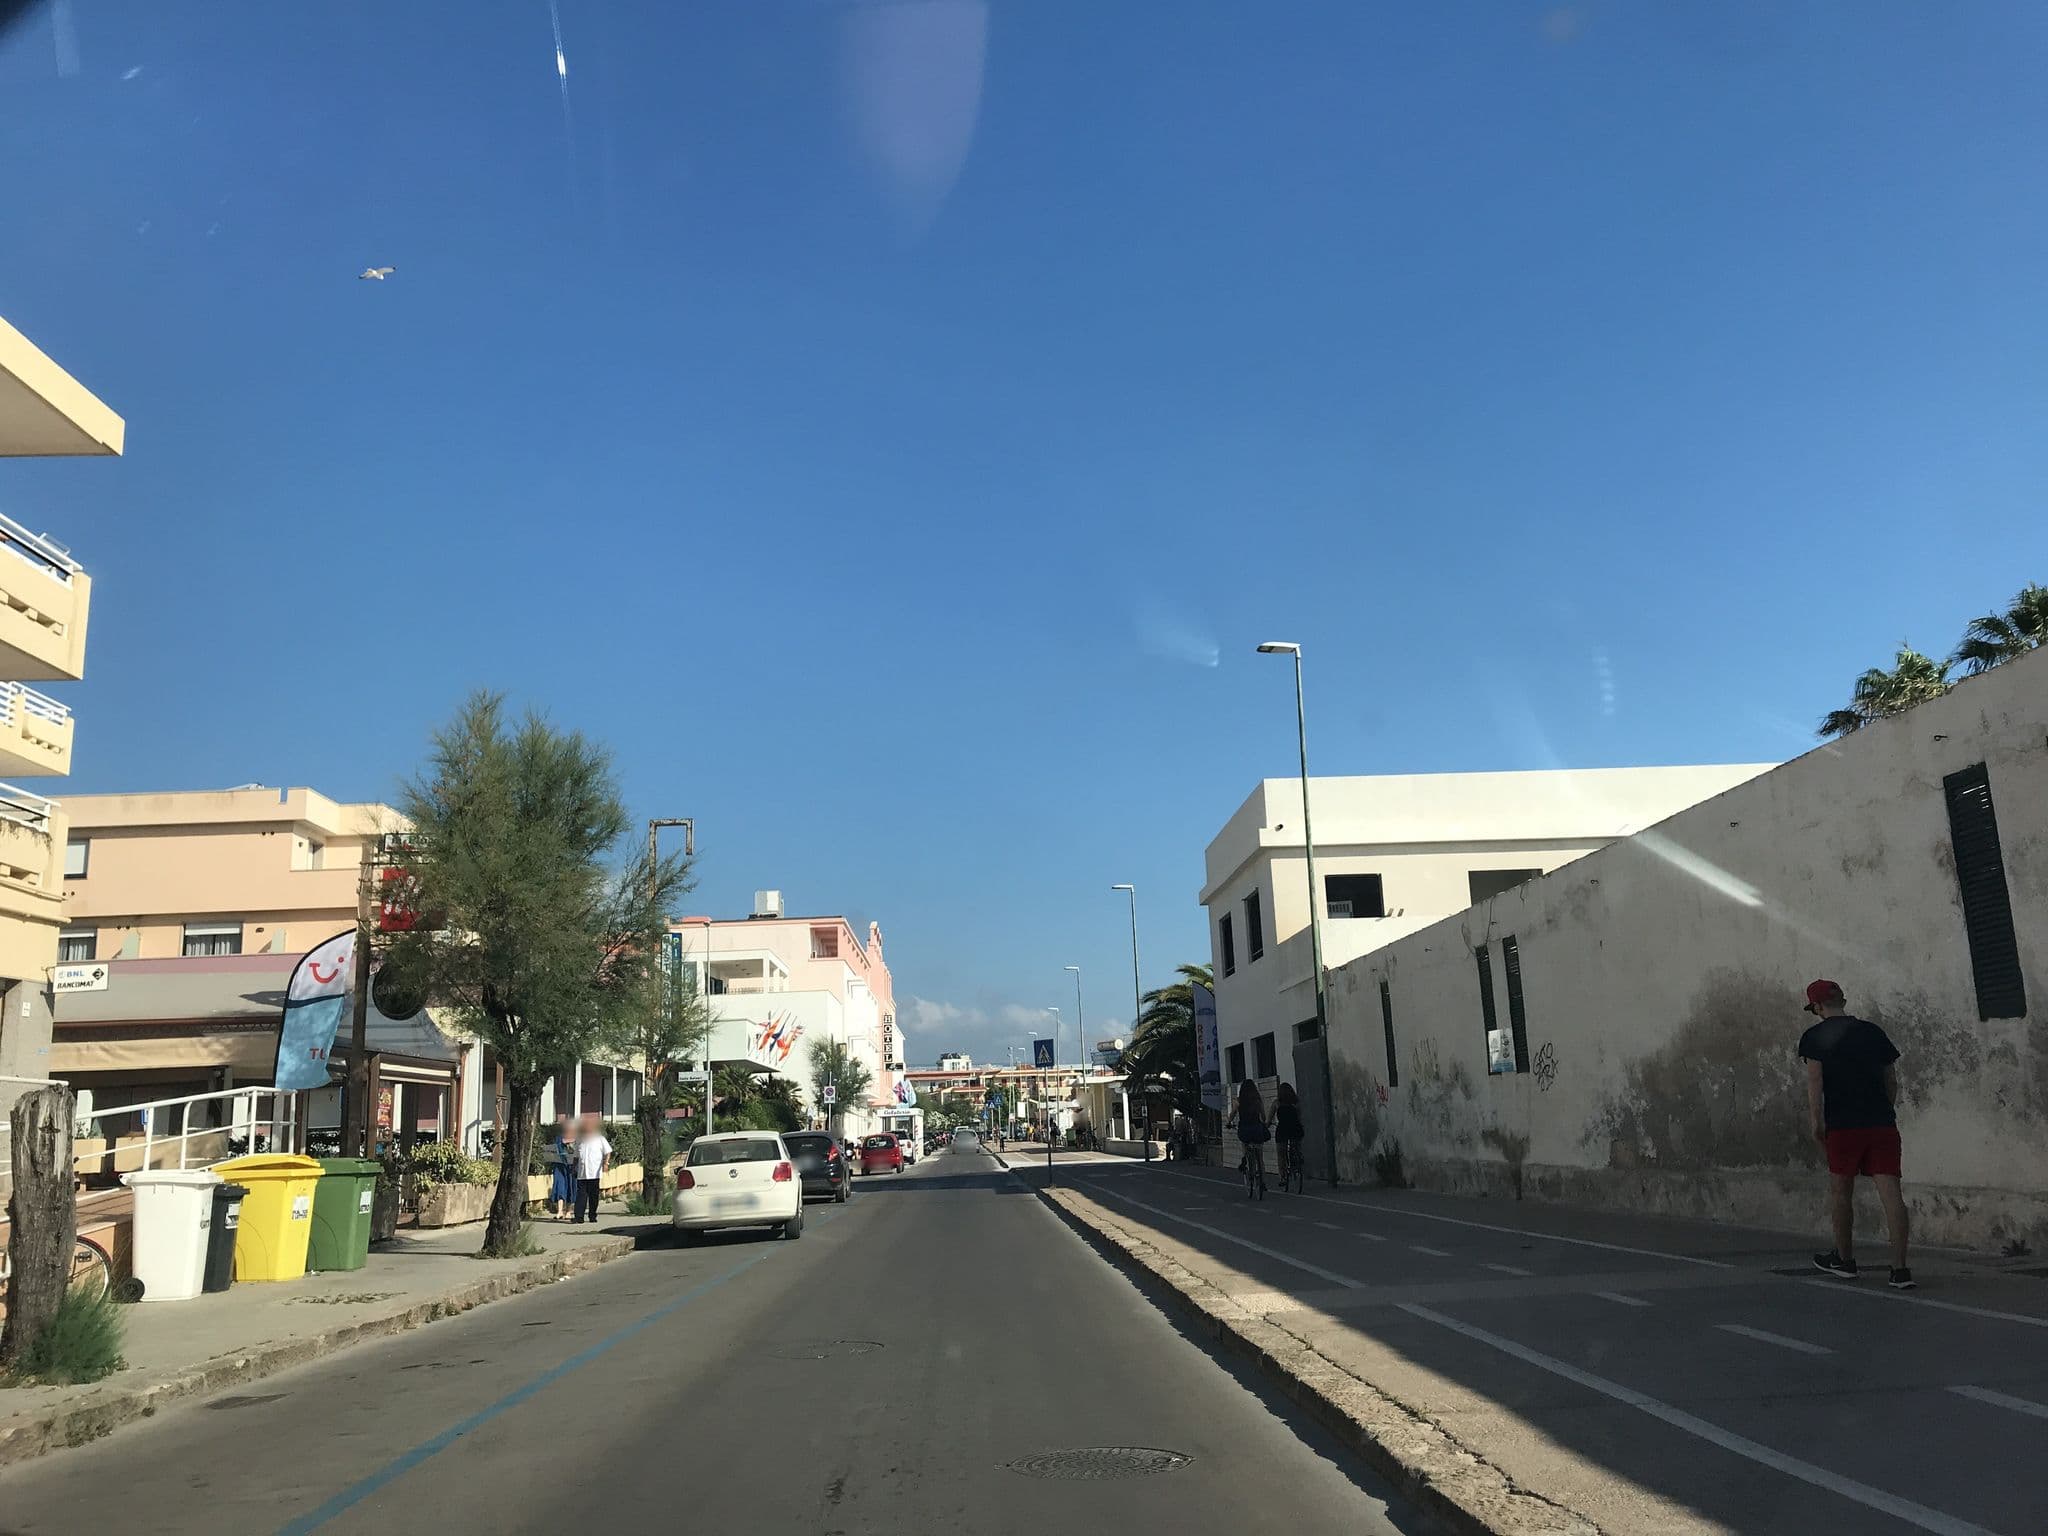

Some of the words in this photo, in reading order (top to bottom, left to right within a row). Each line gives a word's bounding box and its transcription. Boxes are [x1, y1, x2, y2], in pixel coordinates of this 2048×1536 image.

[66, 970, 85, 978] BNL
[57, 980, 95, 989] BANCOMAT
[883, 1014, 893, 1062] HOTEL
